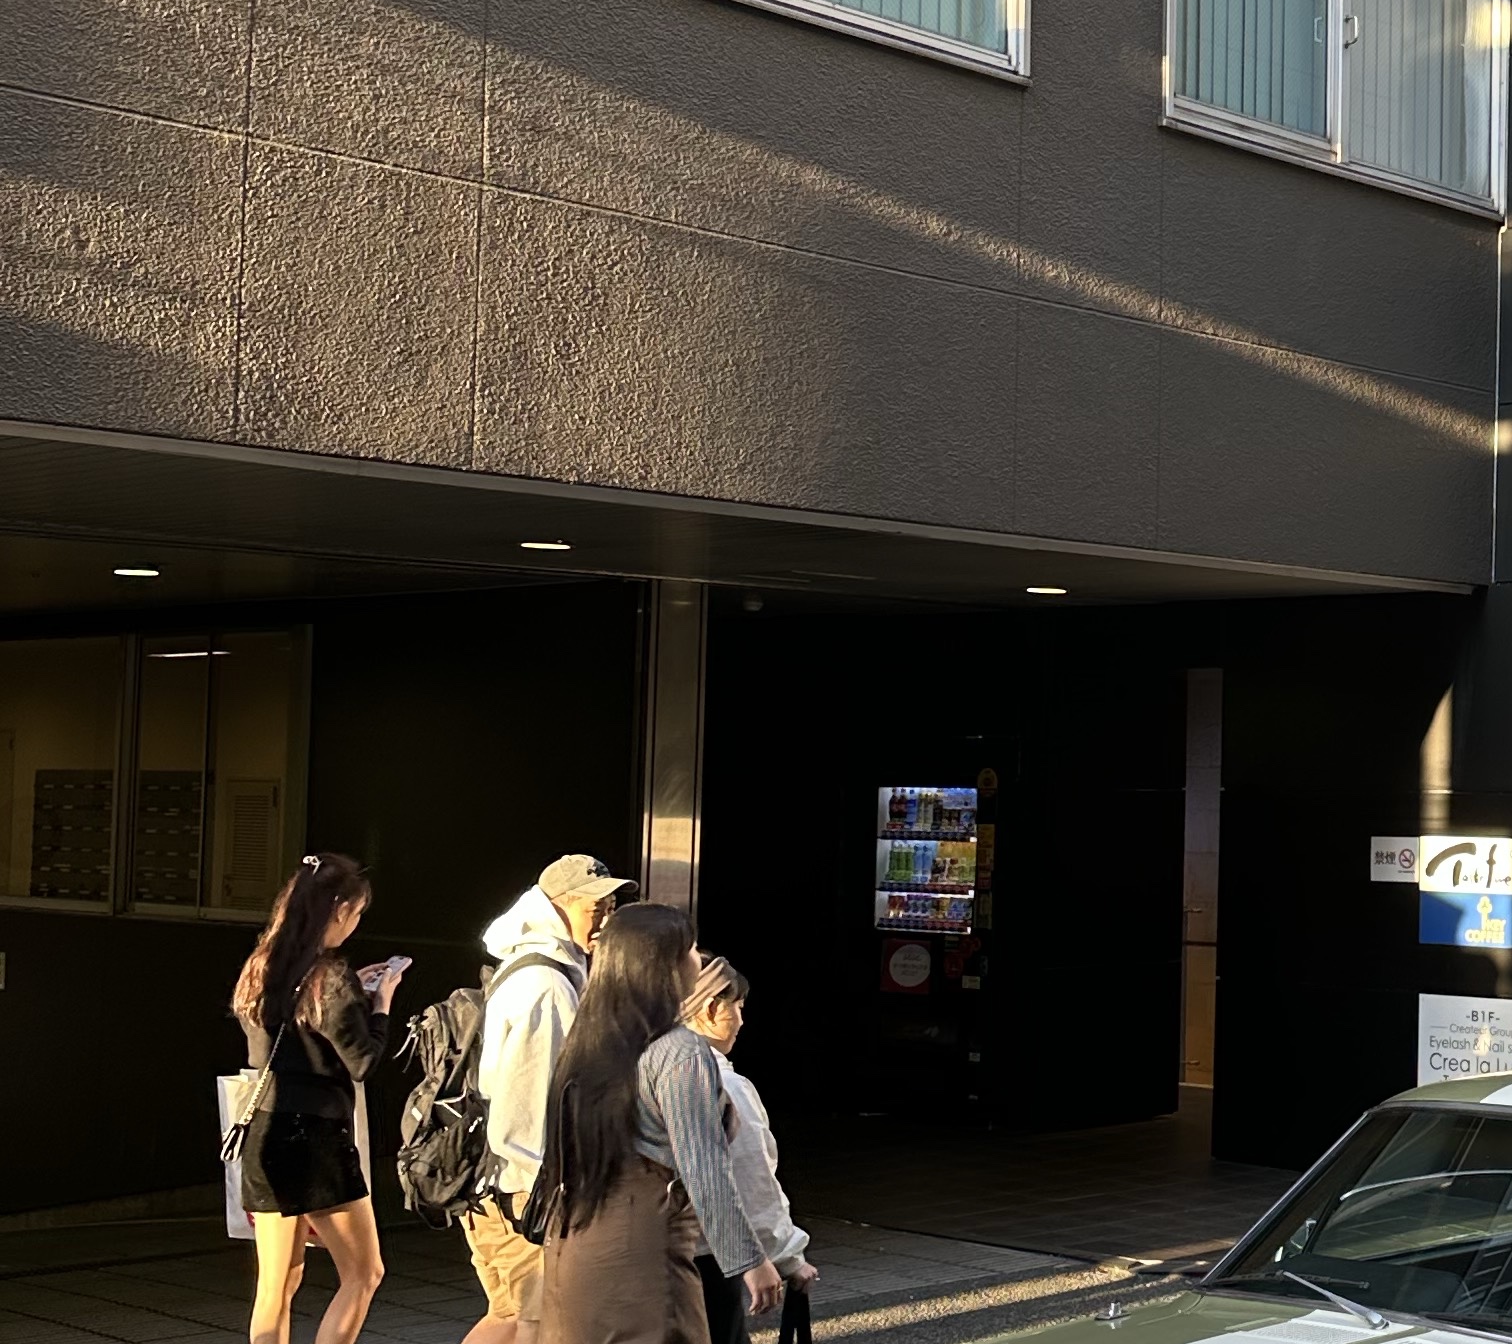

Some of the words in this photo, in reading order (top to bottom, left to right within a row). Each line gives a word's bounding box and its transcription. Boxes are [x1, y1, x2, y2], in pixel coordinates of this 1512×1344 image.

[1429, 1035, 1471, 1050] Eyelash
[1484, 1040, 1505, 1053] Nail
[1429, 1052, 1471, 1072] Crea
[1476, 1056, 1491, 1074] la
